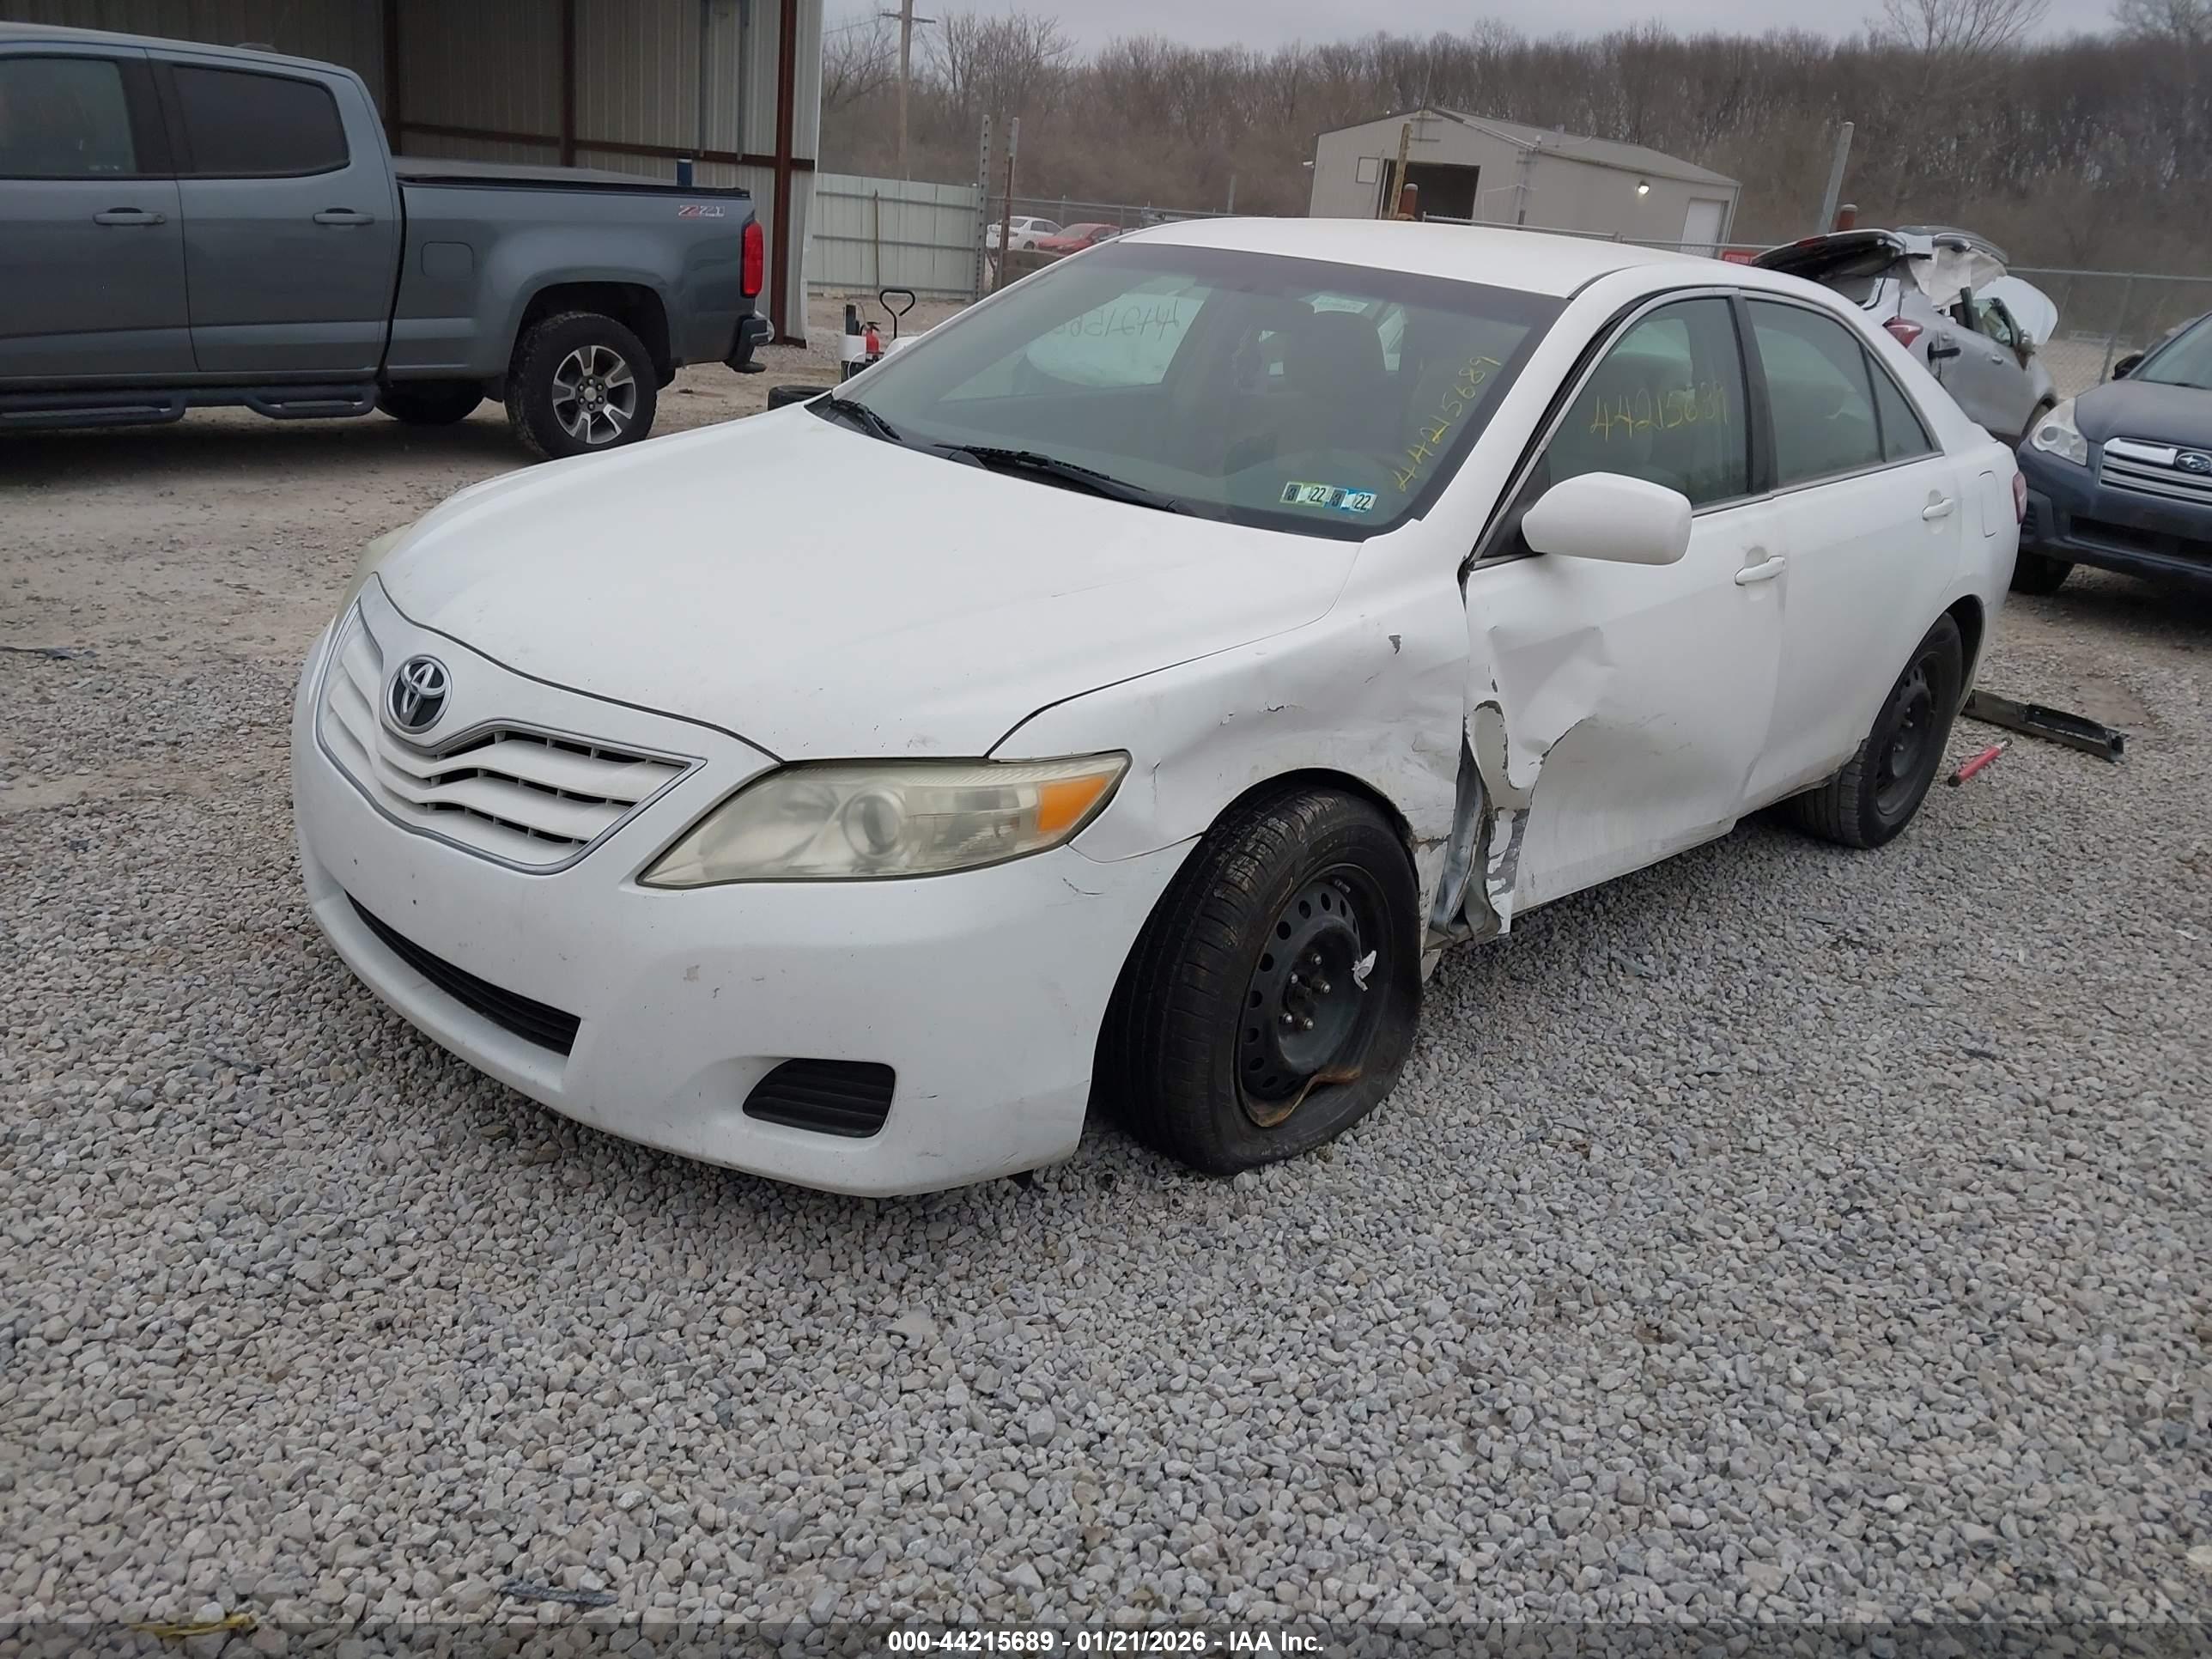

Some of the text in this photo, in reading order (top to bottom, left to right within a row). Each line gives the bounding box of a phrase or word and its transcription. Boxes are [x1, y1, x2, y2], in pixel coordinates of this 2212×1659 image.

[1393, 356, 1502, 492] 44215689
[1310, 487, 1326, 502] 22
[1354, 494, 1371, 511] 22
